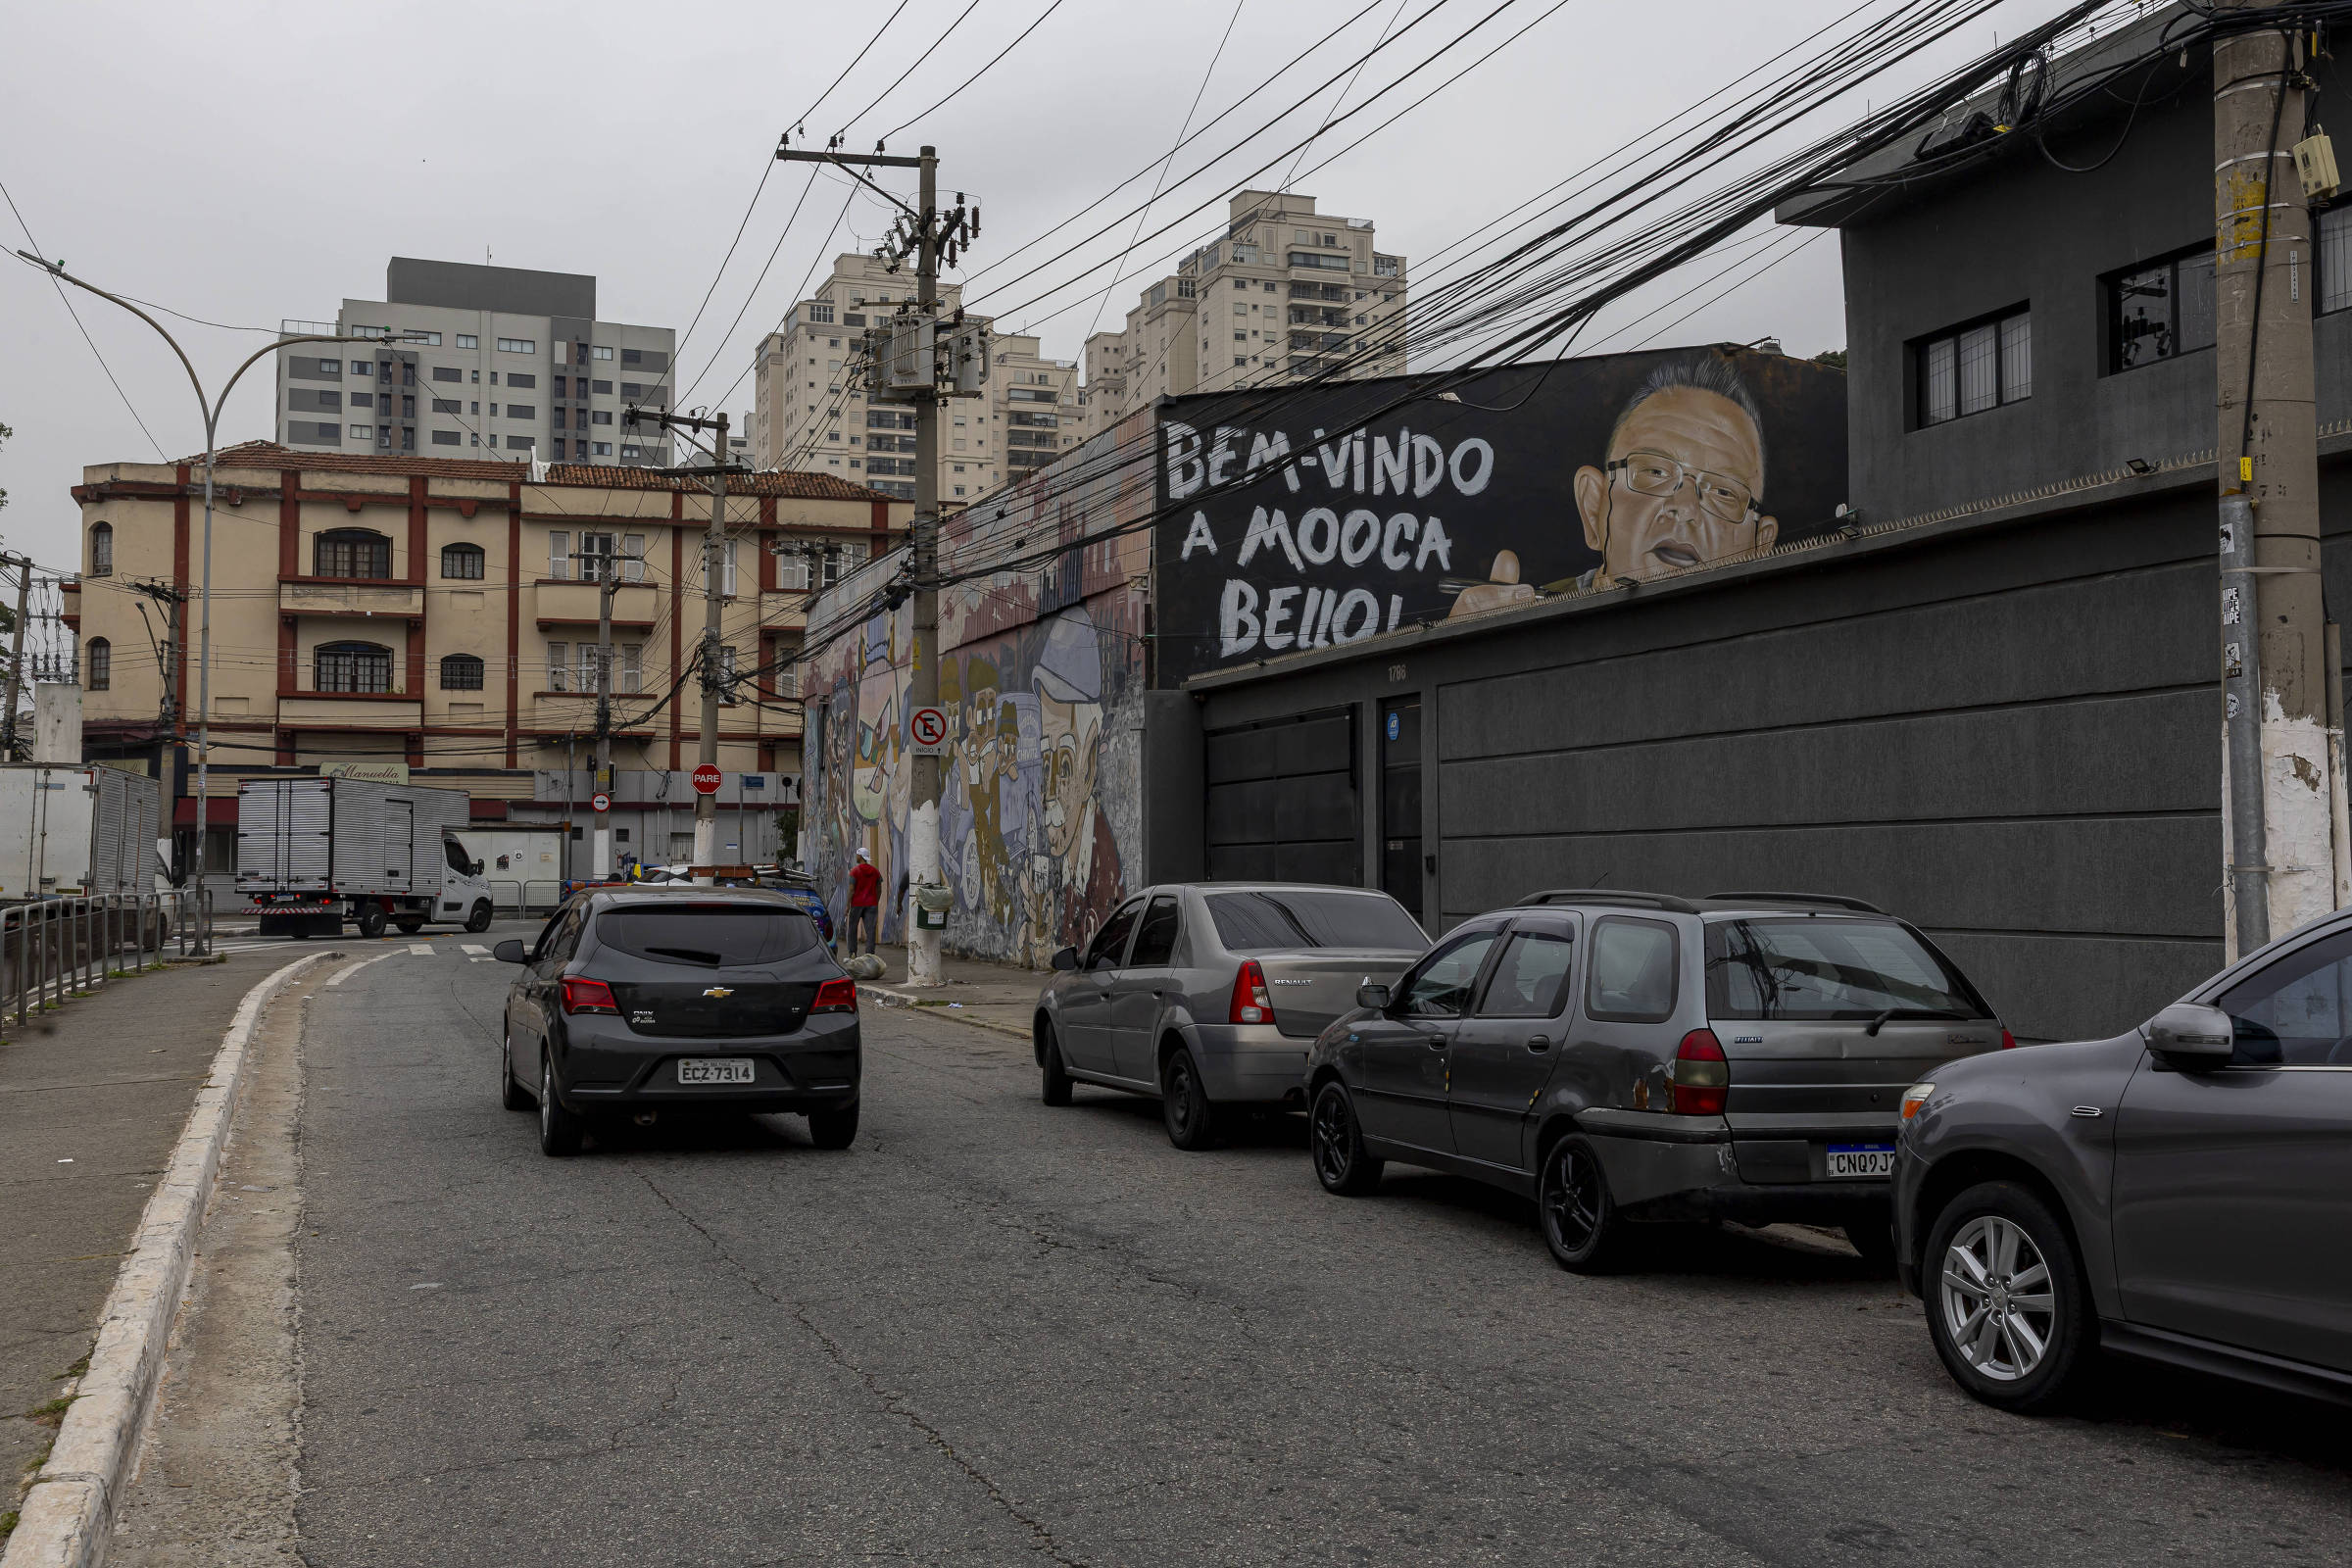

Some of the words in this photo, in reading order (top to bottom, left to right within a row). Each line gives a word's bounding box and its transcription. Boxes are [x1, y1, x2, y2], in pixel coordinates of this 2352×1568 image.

[1161, 419, 1494, 499] BEM-VINDO
[1181, 511, 1218, 562] A
[1237, 506, 1452, 573] MOOCA
[344, 764, 400, 778] Manuella
[694, 774, 720, 783] PARE
